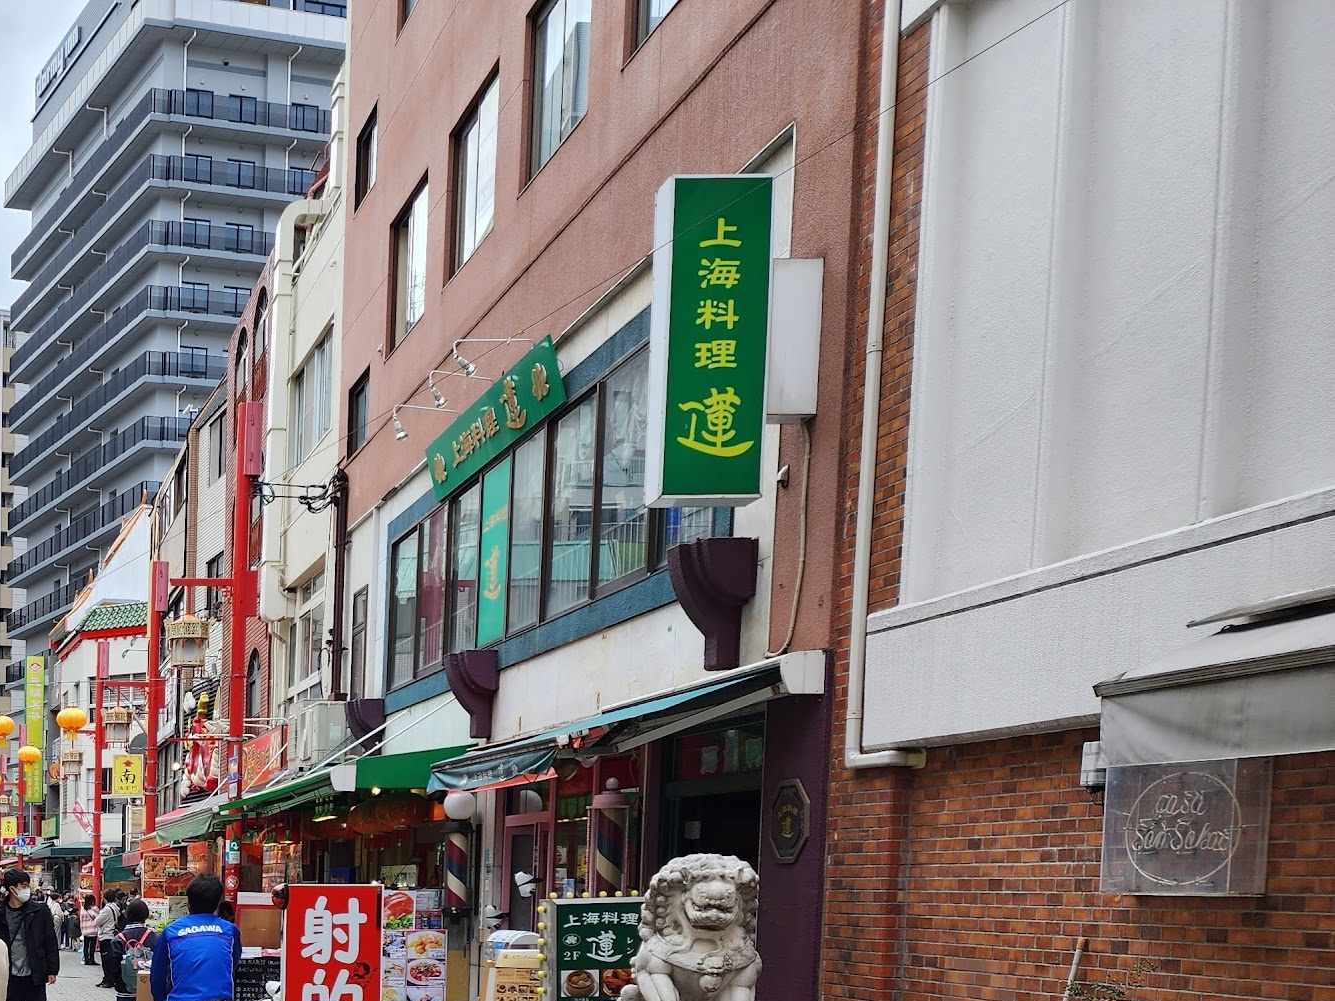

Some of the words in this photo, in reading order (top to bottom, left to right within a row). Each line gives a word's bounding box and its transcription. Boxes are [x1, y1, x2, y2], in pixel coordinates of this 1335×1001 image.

[693, 217, 743, 370] 上海料理
[451, 406, 500, 469] 上海料理
[120, 768, 136, 784] 南
[563, 911, 640, 929] 上海料理
[177, 923, 224, 937] SAGAWA
[626, 936, 635, 955] レン
[563, 950, 582, 961] 2F
